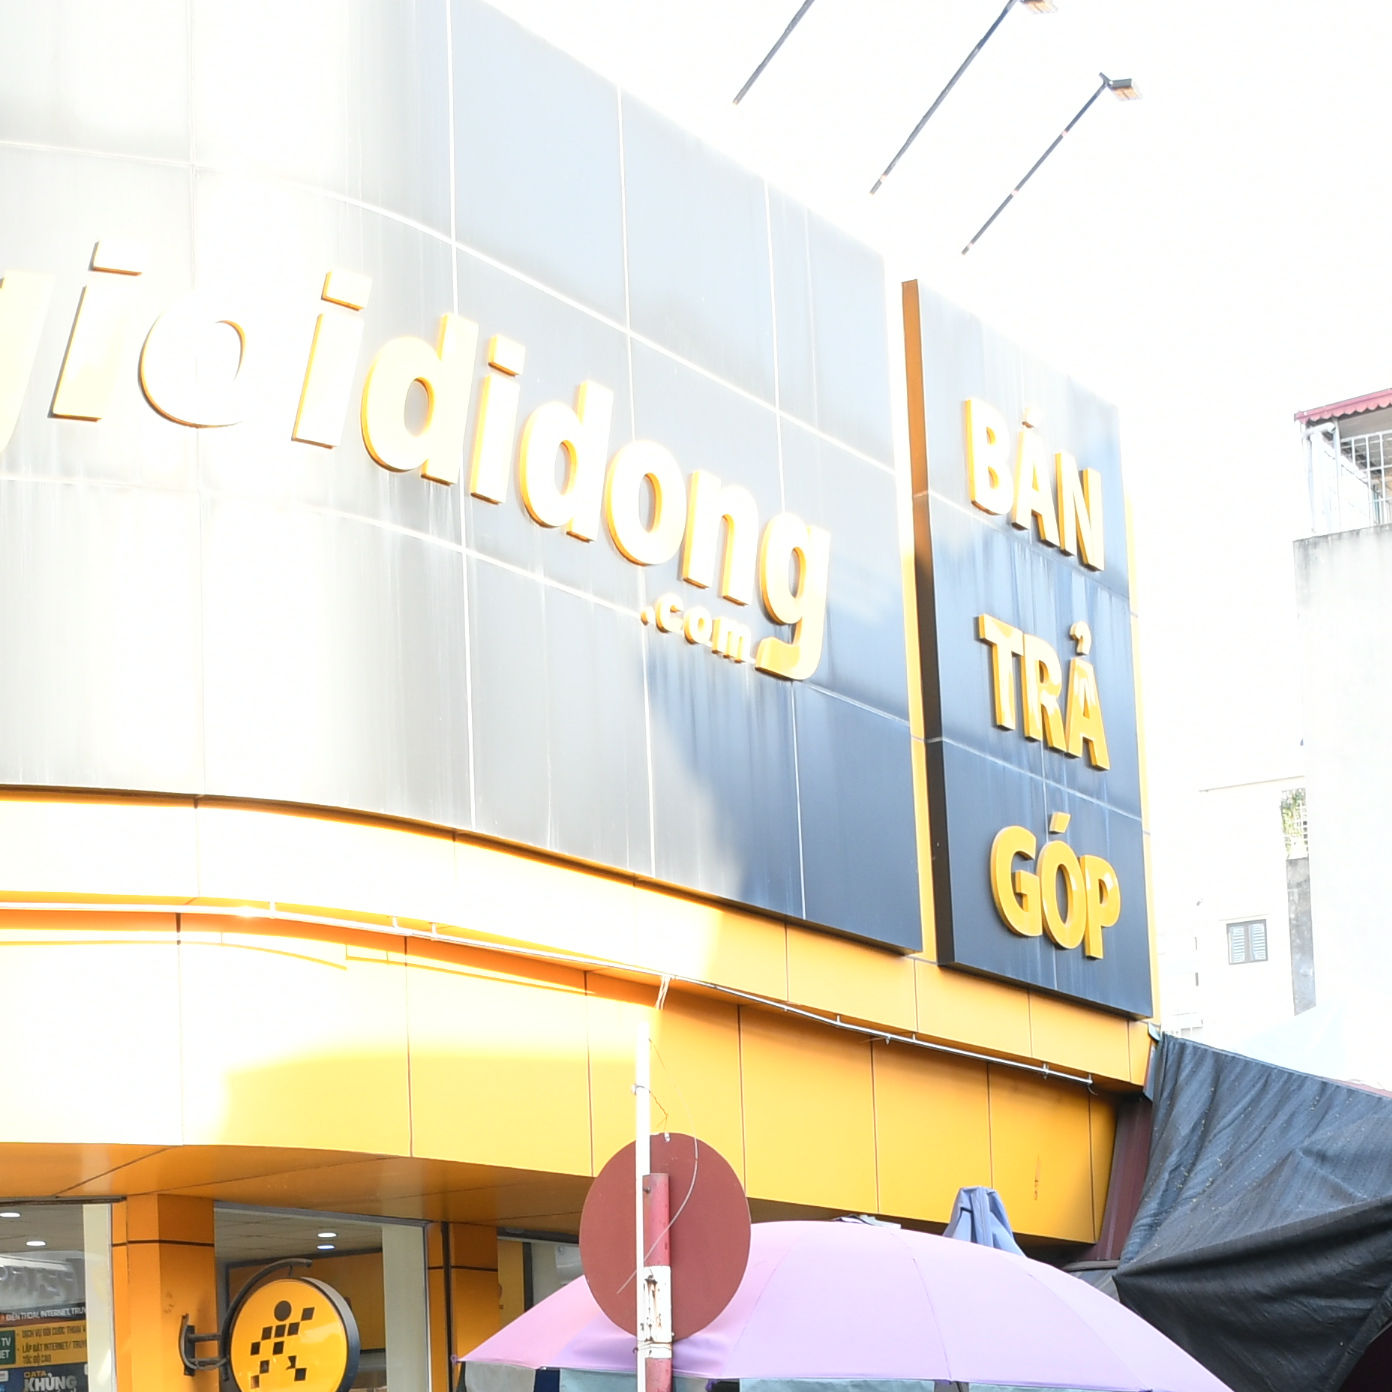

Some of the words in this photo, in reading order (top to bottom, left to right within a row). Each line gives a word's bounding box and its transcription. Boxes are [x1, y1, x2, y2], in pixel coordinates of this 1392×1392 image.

[964, 396, 1105, 572] BÁN
[640, 591, 753, 667] .com
[976, 614, 1110, 771] TRẢ
[990, 812, 1121, 960] GÓP
